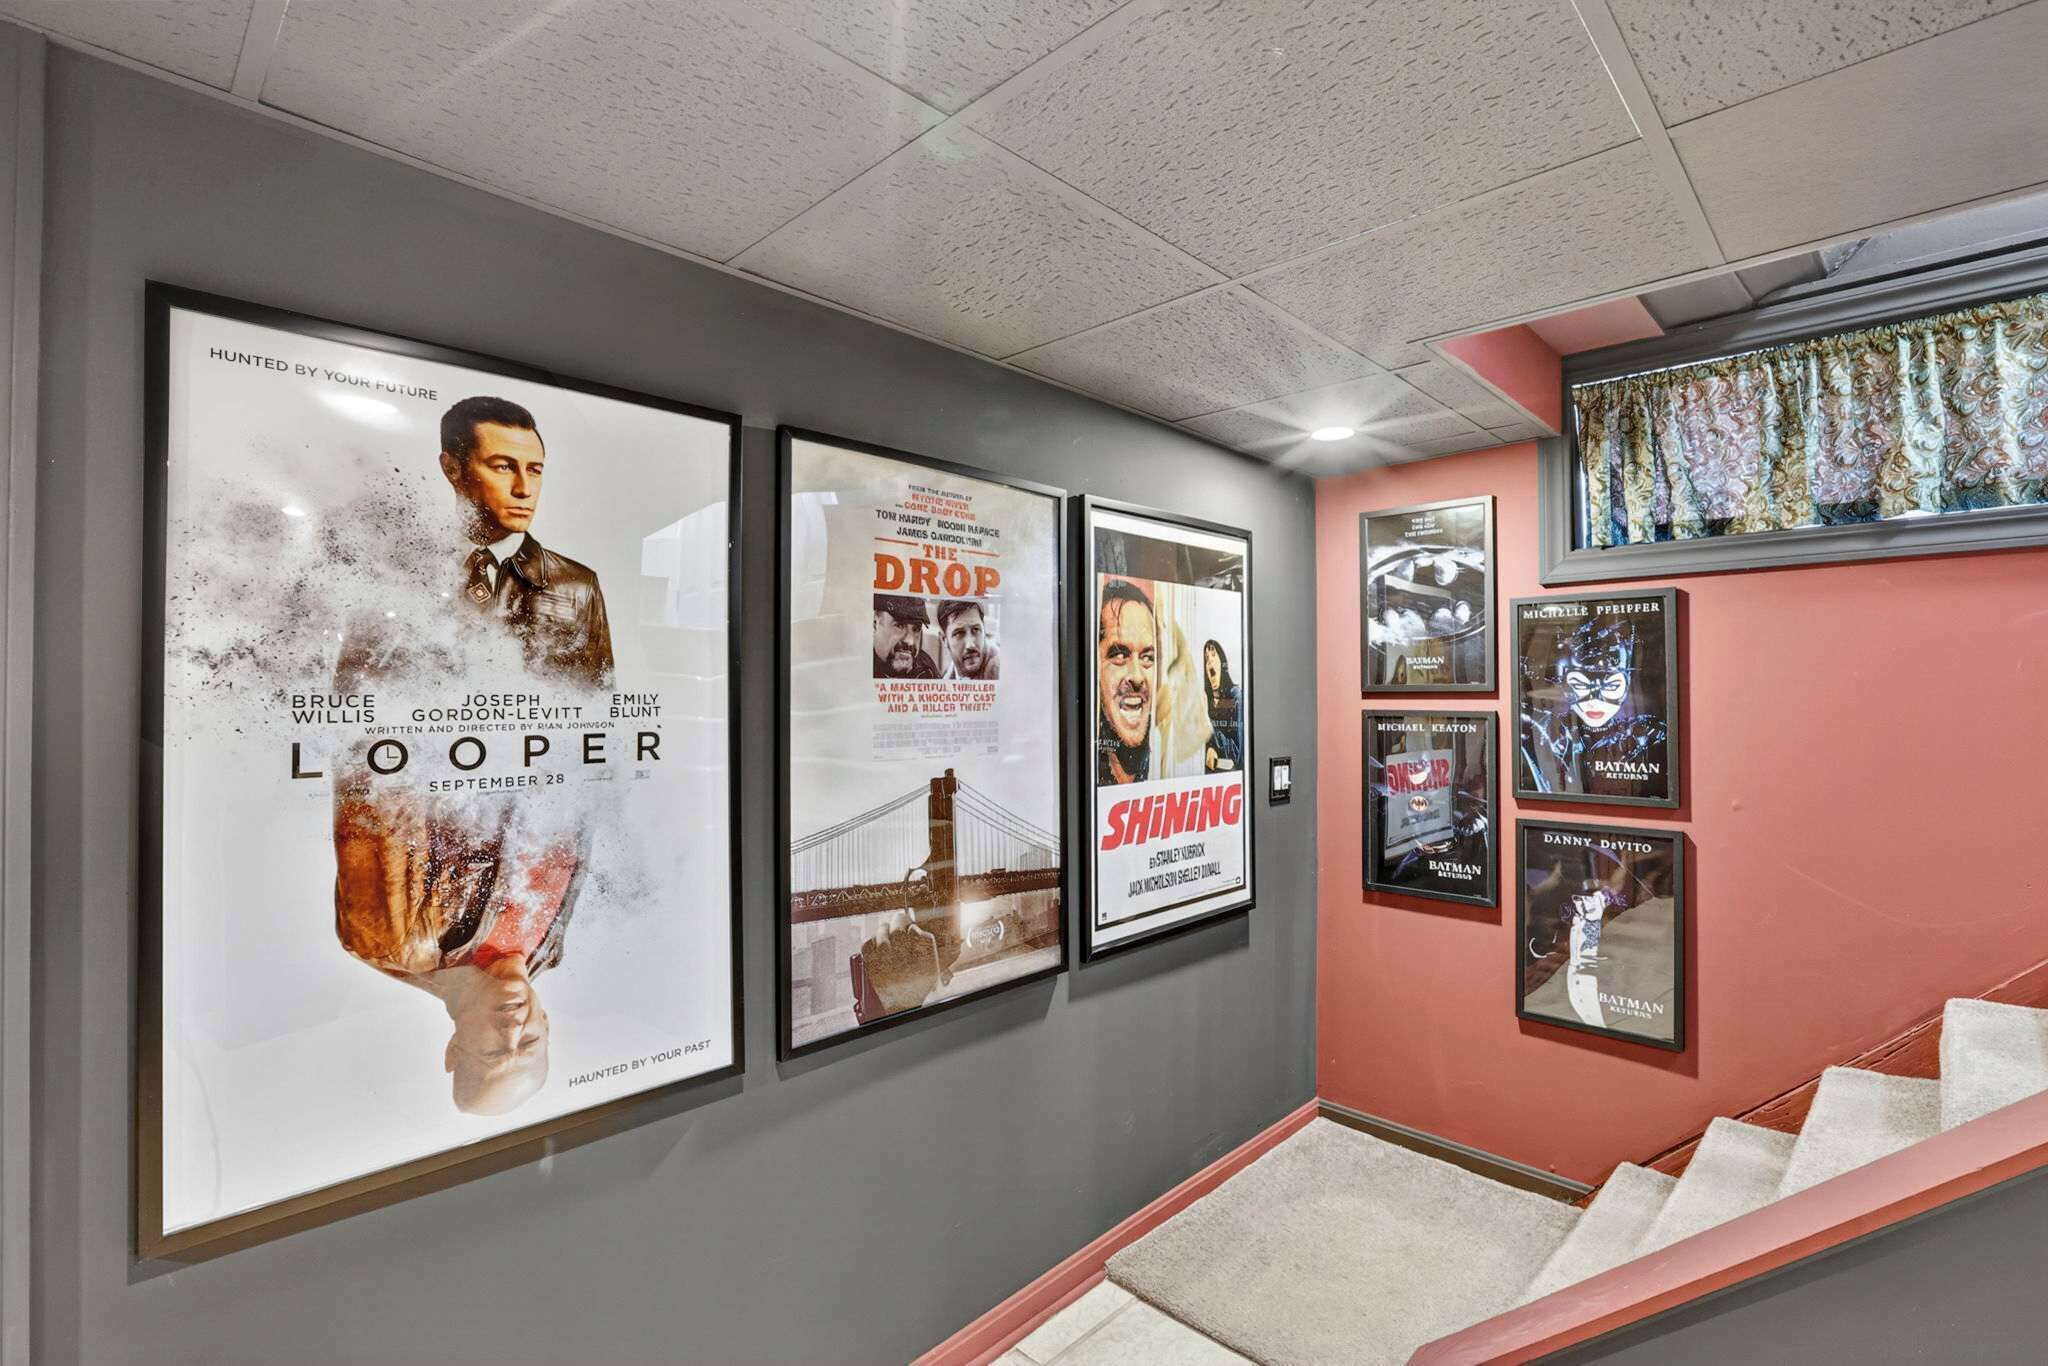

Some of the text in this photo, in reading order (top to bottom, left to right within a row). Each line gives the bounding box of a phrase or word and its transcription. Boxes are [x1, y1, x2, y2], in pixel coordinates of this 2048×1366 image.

[209, 347, 438, 401] HUNTED BY YOUR FUTURE
[876, 509, 897, 521] TOM
[898, 513, 931, 527] HARDY
[896, 526, 928, 540] JAMES
[922, 543, 958, 561] THE
[873, 552, 1001, 598] DROP
[1522, 602, 1661, 620] MICHELLE PFEIFFER
[1406, 655, 1445, 666] BATMAN
[890, 682, 949, 692] MASTERFUL
[952, 683, 995, 692] THRILLER
[291, 694, 376, 710] BRUCE
[461, 693, 541, 708] JOSEPH
[611, 693, 660, 706] EMILY
[878, 693, 996, 703] WITH A KNOCKOUT CAST
[411, 706, 583, 723] GORDON-LEVITT
[609, 705, 662, 719] BLUNT
[887, 703, 909, 713] AND
[911, 703, 919, 713] A
[922, 703, 956, 713] KILLER
[291, 709, 376, 725] WILLIS
[364, 725, 423, 736] WRITTEN
[428, 724, 454, 734] AND
[458, 723, 516, 733] DIRECTED
[520, 722, 533, 732] BY
[566, 720, 615, 730] JOHNSON
[1377, 723, 1477, 733] MICHAEL KEATON
[290, 730, 662, 780] LOOPER
[1595, 760, 1660, 774] BATMAN
[428, 774, 539, 793] SEPTEMBER
[546, 773, 565, 786] 28
[1543, 833, 1652, 853] DANNY DeVITO
[1429, 860, 1482, 875] BATMAN
[1599, 992, 1664, 1014] BATMAN
[568, 1039, 712, 1088] HAUNTED BY YOUR PAST
